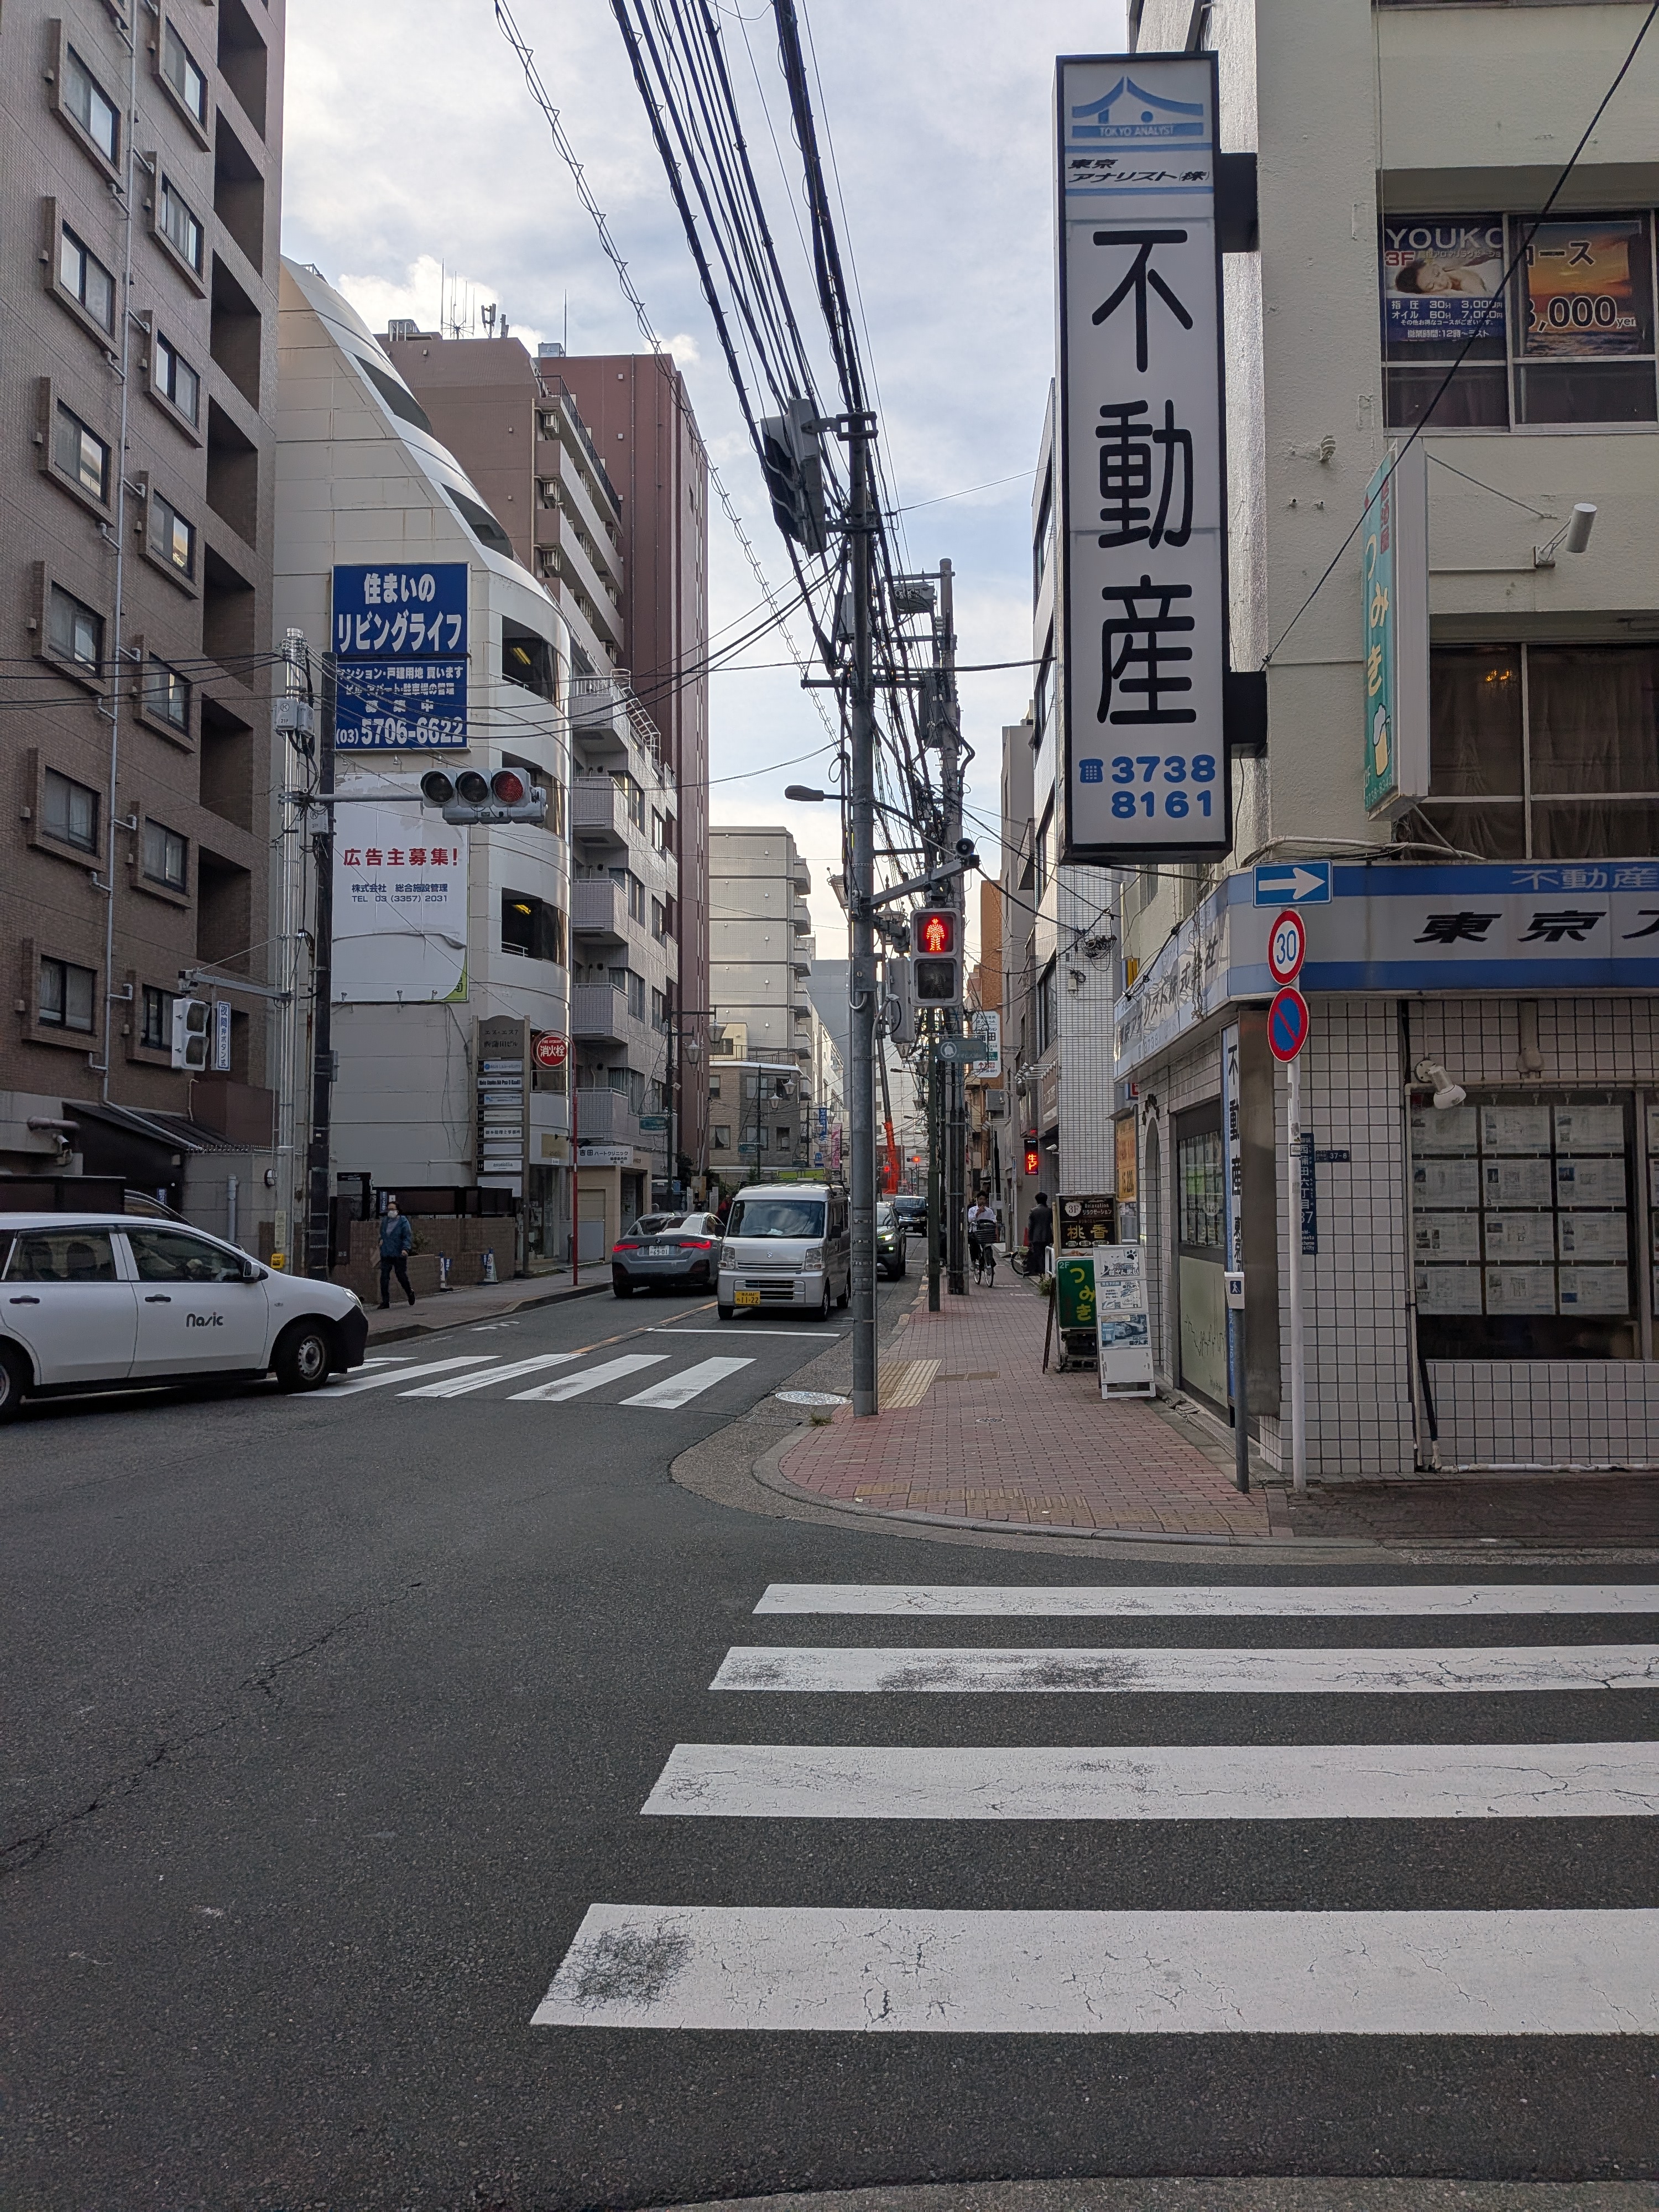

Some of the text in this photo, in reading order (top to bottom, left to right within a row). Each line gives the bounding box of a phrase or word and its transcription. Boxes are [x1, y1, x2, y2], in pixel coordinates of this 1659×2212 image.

[1099, 125, 1174, 137] TOKYO ANALYST
[1068, 159, 1118, 169] 東京
[1385, 251, 1415, 267] 3F
[1392, 311, 1419, 319] オイル
[1092, 229, 1196, 725] 不動産
[364, 573, 435, 604] 住まいの
[1365, 533, 1389, 697] つみき
[338, 609, 462, 652] リビングライフ
[427, 666, 463, 679] 買います
[1112, 754, 1216, 784] 3738
[1111, 790, 1213, 818] 8161
[343, 848, 457, 866] 広告主募集!
[351, 883, 448, 893] 株式会社 総合施設管理
[1511, 867, 1659, 890] 不動産
[1276, 930, 1297, 964] 30
[540, 1045, 565, 1057] 消火栓
[1227, 1046, 1241, 1196] 不動産
[1068, 1205, 1079, 1213] 3F
[1067, 1224, 1109, 1240] 桃香
[1070, 1267, 1095, 1321] つみき
